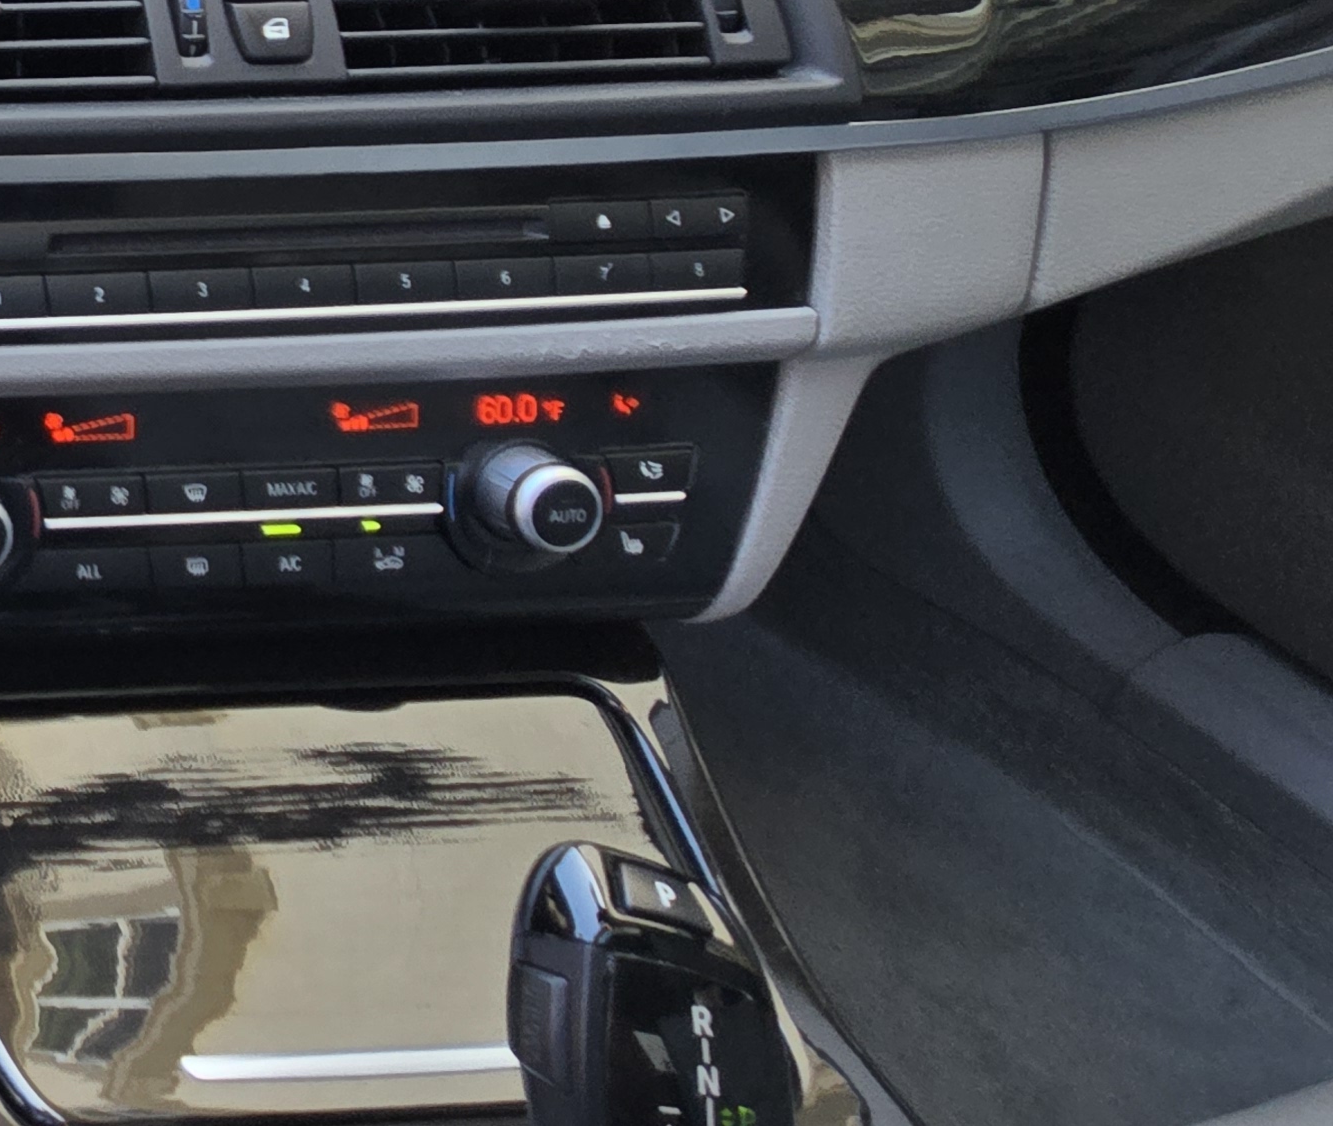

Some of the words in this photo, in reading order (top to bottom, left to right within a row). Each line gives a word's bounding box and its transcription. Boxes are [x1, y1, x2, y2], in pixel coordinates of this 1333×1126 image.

[400, 273, 411, 289] 5
[500, 270, 512, 285] 6
[94, 286, 106, 303] 2
[197, 281, 208, 298] 3
[477, 393, 537, 425] 60.0
[549, 508, 587, 523] AUTO
[76, 563, 103, 580] ALL
[654, 881, 677, 908] P
[691, 1005, 714, 1037] R
[697, 1065, 720, 1097] N
